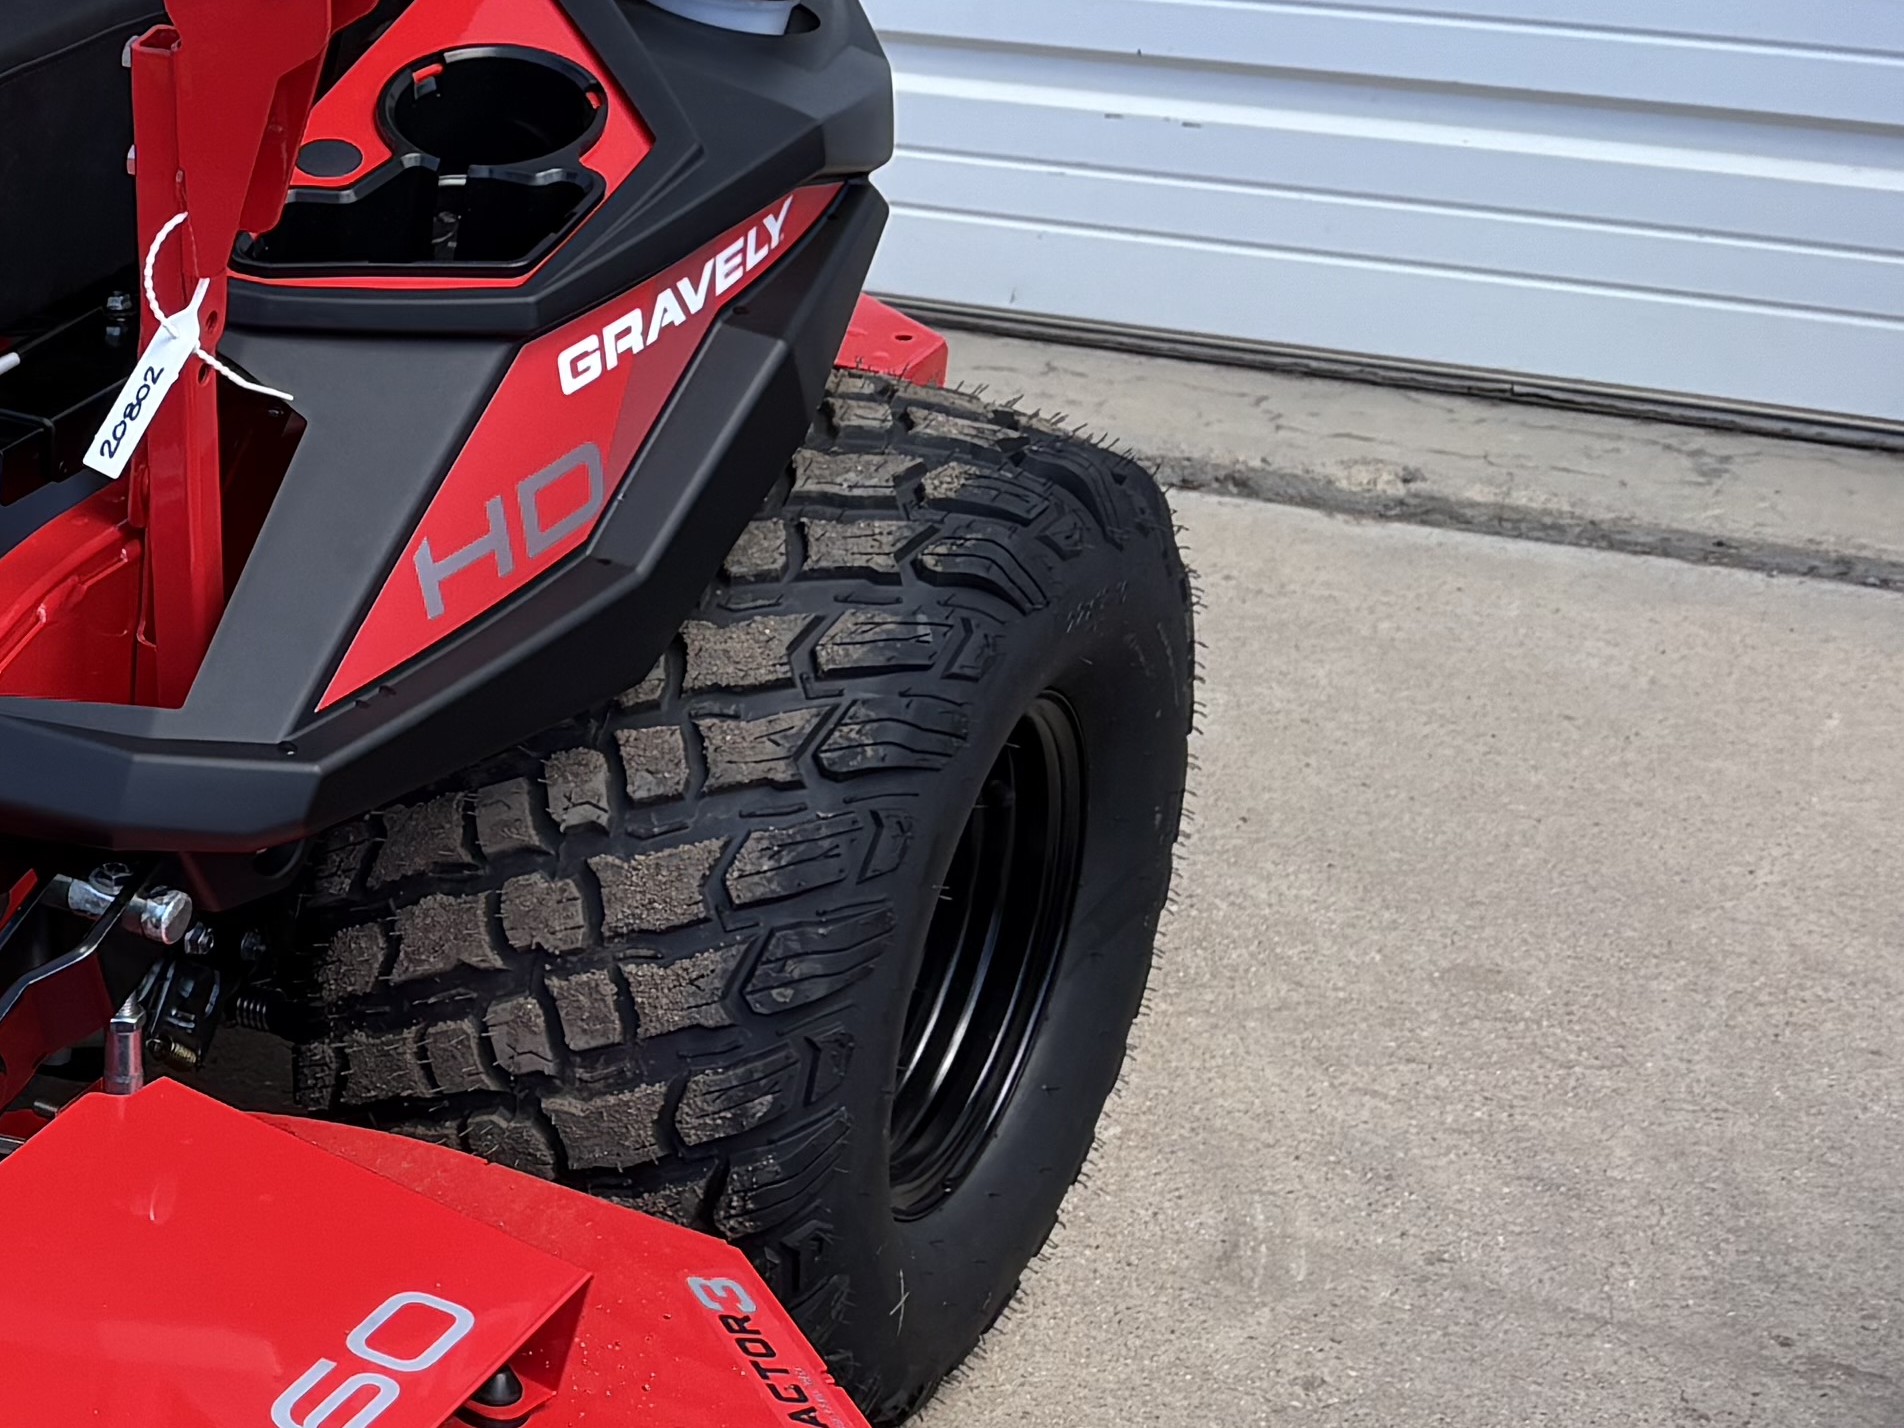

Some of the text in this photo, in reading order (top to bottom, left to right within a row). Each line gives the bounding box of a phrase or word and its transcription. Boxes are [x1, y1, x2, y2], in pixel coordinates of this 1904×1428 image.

[557, 194, 794, 396] GRAVELY
[100, 365, 165, 460] 20802
[413, 441, 604, 620] HD
